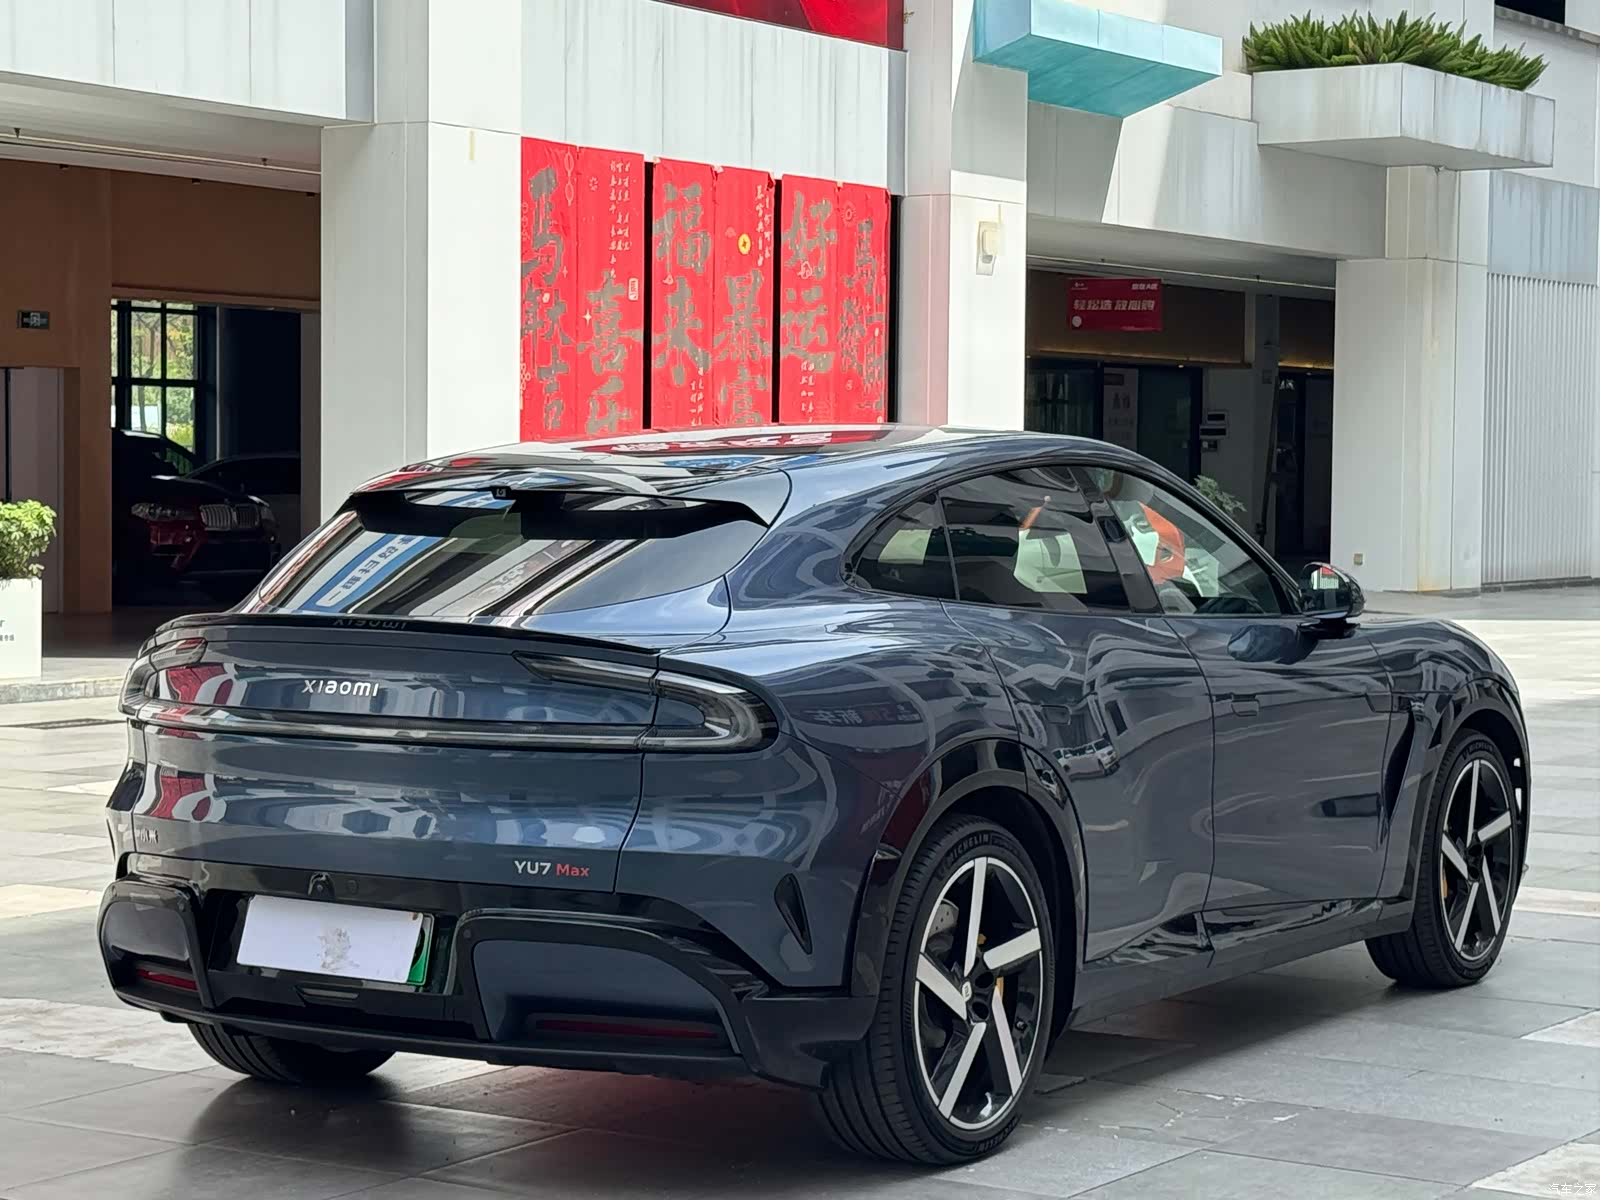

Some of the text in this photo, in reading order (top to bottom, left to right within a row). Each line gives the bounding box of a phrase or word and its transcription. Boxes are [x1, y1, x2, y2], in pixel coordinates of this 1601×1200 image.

[653, 182, 712, 386] 福来
[781, 190, 838, 375] 好运
[513, 860, 590, 877] YU7 Max
